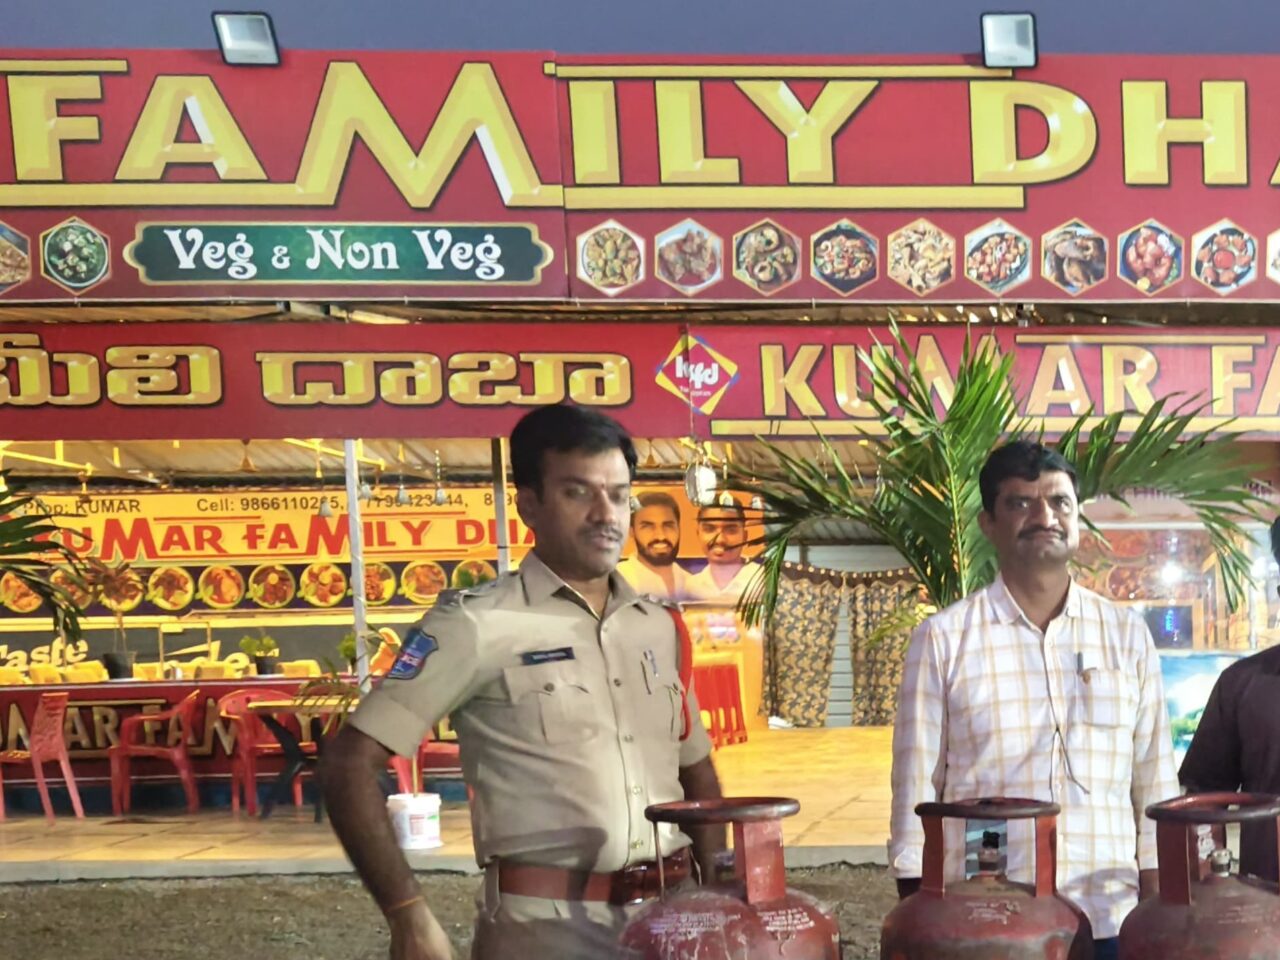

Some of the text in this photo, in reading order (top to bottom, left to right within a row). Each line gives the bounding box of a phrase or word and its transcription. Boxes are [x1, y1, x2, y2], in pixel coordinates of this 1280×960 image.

[7, 61, 879, 208] FAMILY
[163, 227, 505, 280] Veg & Non Veg
[256, 351, 632, 406] దాబా
[75, 499, 141, 516] KUMAR
[196, 498, 235, 512] Cell:
[240, 494, 345, 512] 986611025,
[32, 517, 229, 561] UMAR
[0, 635, 90, 671] aste
